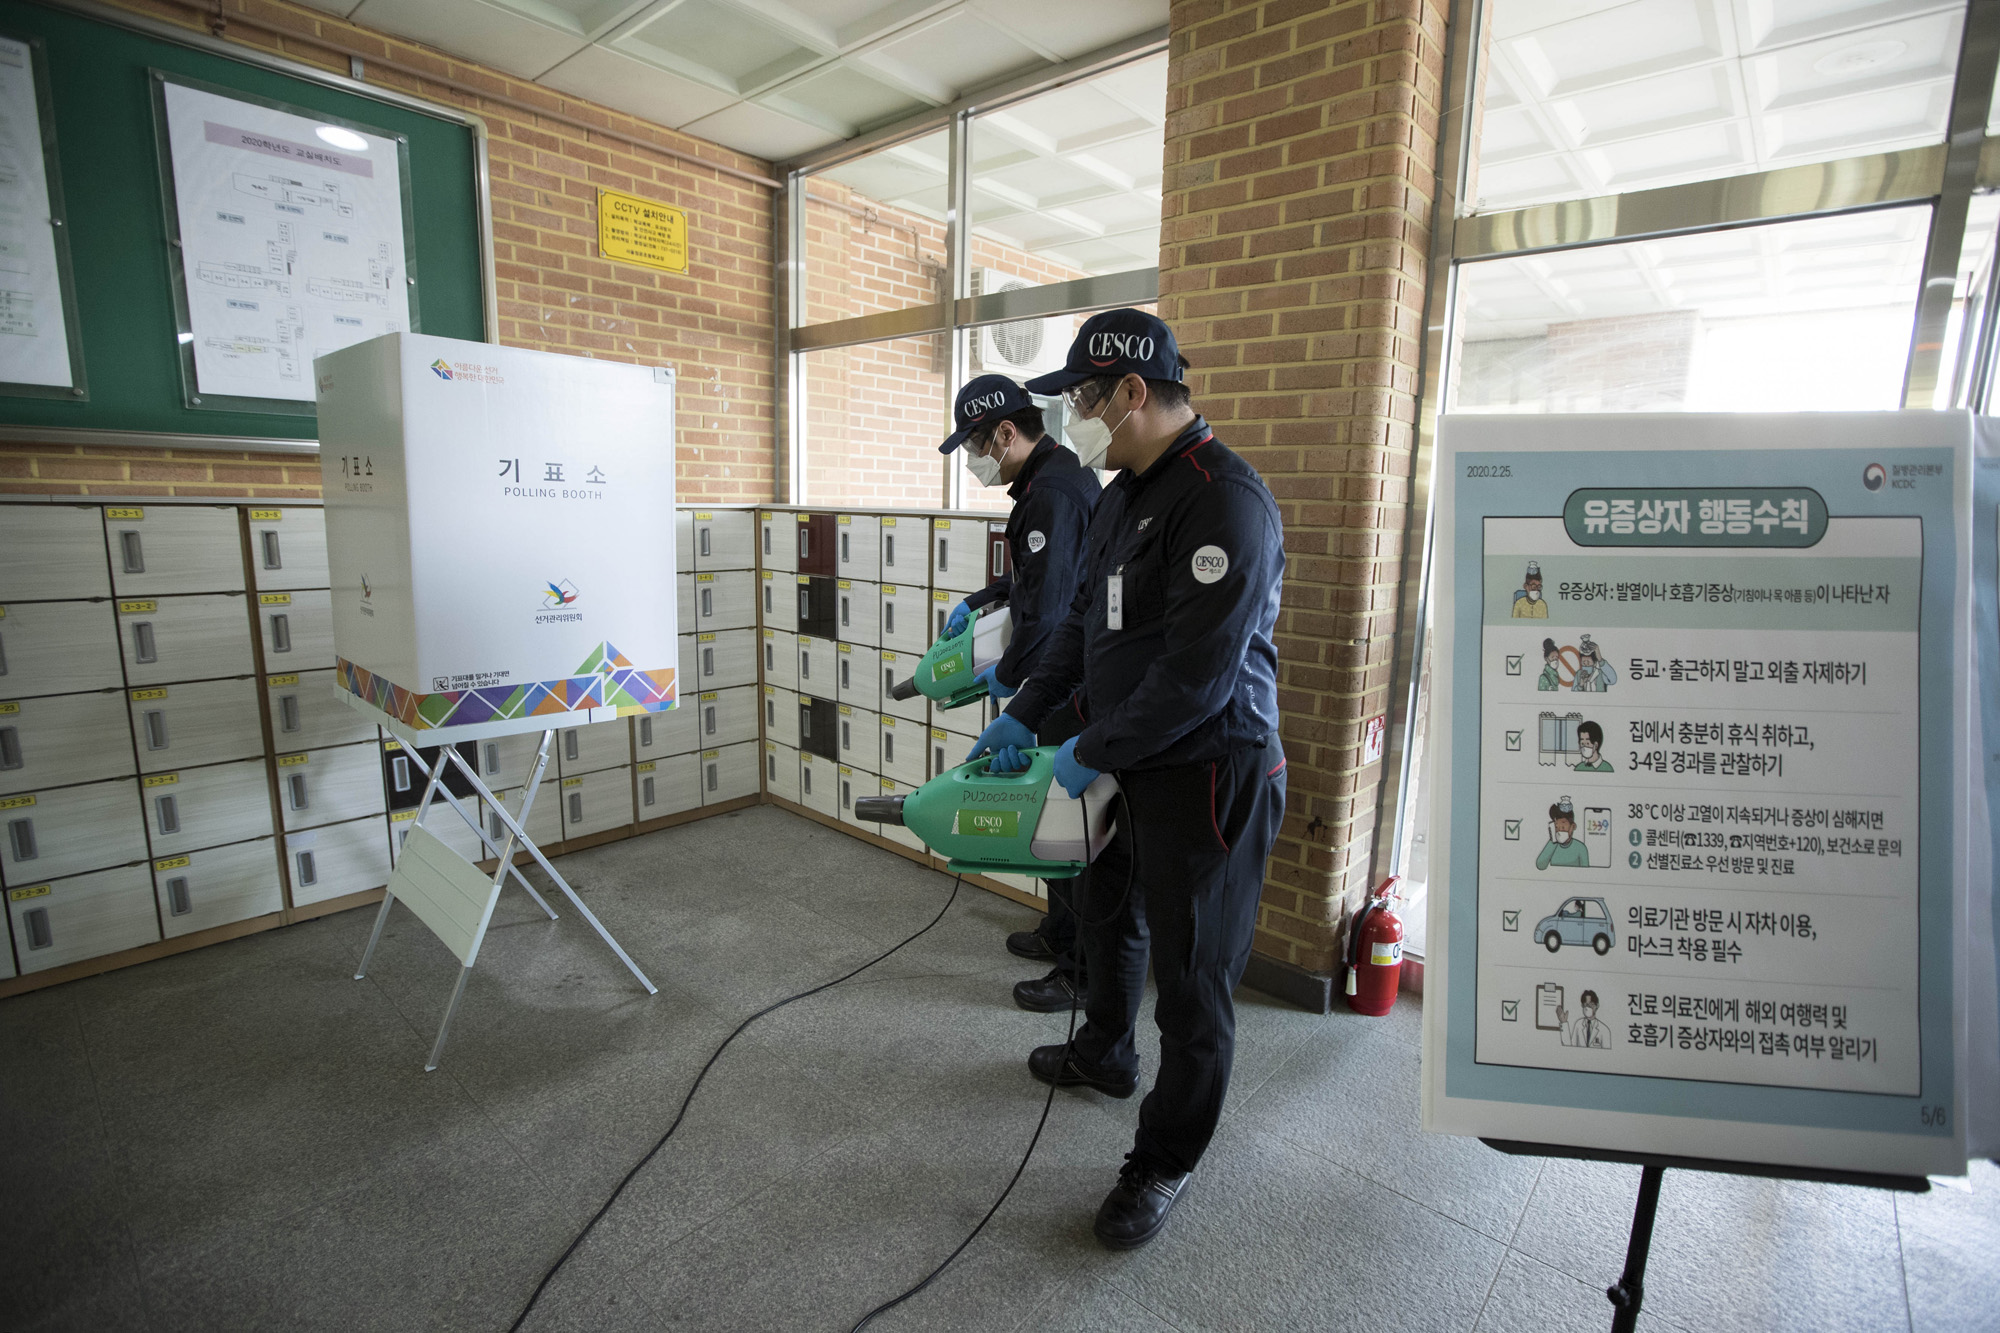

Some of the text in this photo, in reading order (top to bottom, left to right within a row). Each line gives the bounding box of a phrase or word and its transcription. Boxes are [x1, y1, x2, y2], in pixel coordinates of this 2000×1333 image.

[241, 136, 342, 166] 2020학년도 교실배치도
[614, 201, 674, 224] CCTV 설치안내
[1089, 332, 1154, 362] CESCO
[454, 362, 498, 375] 아름다운 선거
[454, 372, 476, 382] 행복한
[964, 390, 1005, 418] CESCO
[1467, 465, 1514, 478] 2020.2.25.
[1892, 480, 1916, 489] KCDC
[504, 487, 602, 500] POLLING BOOTH
[1584, 500, 1808, 534] 유증상자 행동수칙
[1030, 536, 1043, 544] CESCO
[1196, 556, 1224, 568] CESCO
[1616, 583, 1666, 601] 발열이나
[1774, 590, 1783, 602] 목
[1784, 589, 1802, 602] 아픔
[1832, 584, 1875, 604] 나타난
[535, 613, 582, 624] 선거관리위원회
[940, 660, 956, 672] CESCO
[1734, 660, 1765, 682] 말고
[1768, 661, 1799, 684] 외출
[1803, 661, 1866, 685] 자제하기
[451, 673, 474, 682] 기표대를
[493, 670, 510, 678] 기대면
[452, 682, 469, 690] 넘어질
[478, 679, 500, 687] 있습니다
[136, 690, 162, 698] 3-3-3
[1629, 720, 1815, 750] 집에서 충분히 휴식 취하고,
[1629, 750, 1782, 777] 3-4일 경과를 관찰하기
[148, 776, 173, 784] 3-3-4
[0, 798, 31, 807] 3-2-24
[963, 790, 1038, 803] PU20020076
[974, 816, 1002, 827] CESCO
[1662, 804, 1684, 822] 이상
[1688, 804, 1724, 824] 고열이
[1726, 806, 1789, 826] 지속되거나
[1792, 808, 1828, 828] 증상이
[1832, 810, 1883, 830] 심해지면
[1587, 819, 1609, 831] 1339
[1827, 837, 1875, 856] 보건소로
[1877, 839, 1902, 857] 문의
[160, 859, 185, 868] 3-3-25
[1646, 852, 1704, 871] 선별진료소
[1706, 854, 1729, 872] 우선
[1732, 855, 1754, 874] 방문
[1757, 856, 1768, 874] 및
[1771, 858, 1794, 875] 진료
[16, 888, 46, 897] 3-2-30
[1628, 906, 1817, 941] 의료기관 방문 시 자차 이용,
[1628, 934, 1742, 963] 마스크 착용 필수
[1628, 993, 1846, 1029] 진료 의료진에게 해외 여행력 및
[1628, 1023, 1877, 1063] 호흡기 증상자와의 접촉 여부 알리기
[1922, 1106, 1946, 1126] 5/6
